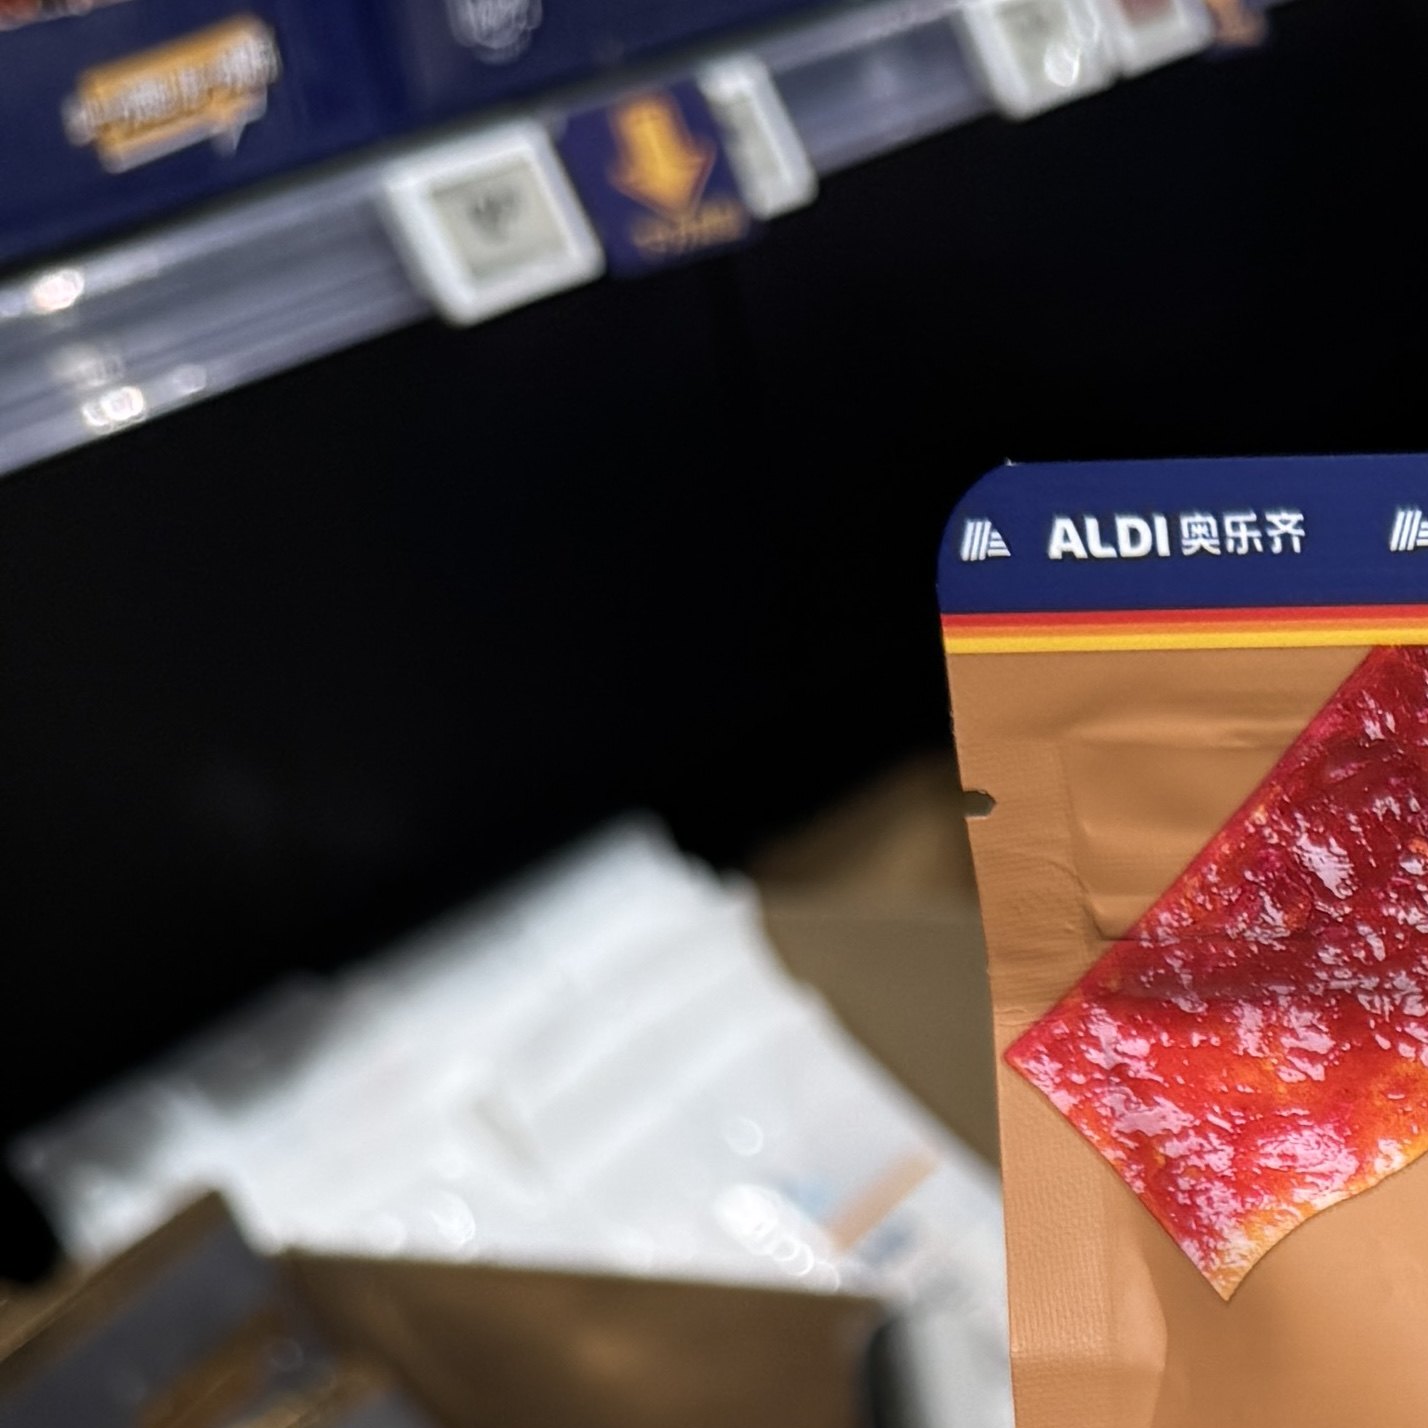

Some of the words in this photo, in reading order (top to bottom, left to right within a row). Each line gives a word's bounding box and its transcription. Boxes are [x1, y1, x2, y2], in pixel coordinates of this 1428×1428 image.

[1049, 516, 1170, 558] ALDI
[1181, 512, 1305, 555] 奥乐齐
